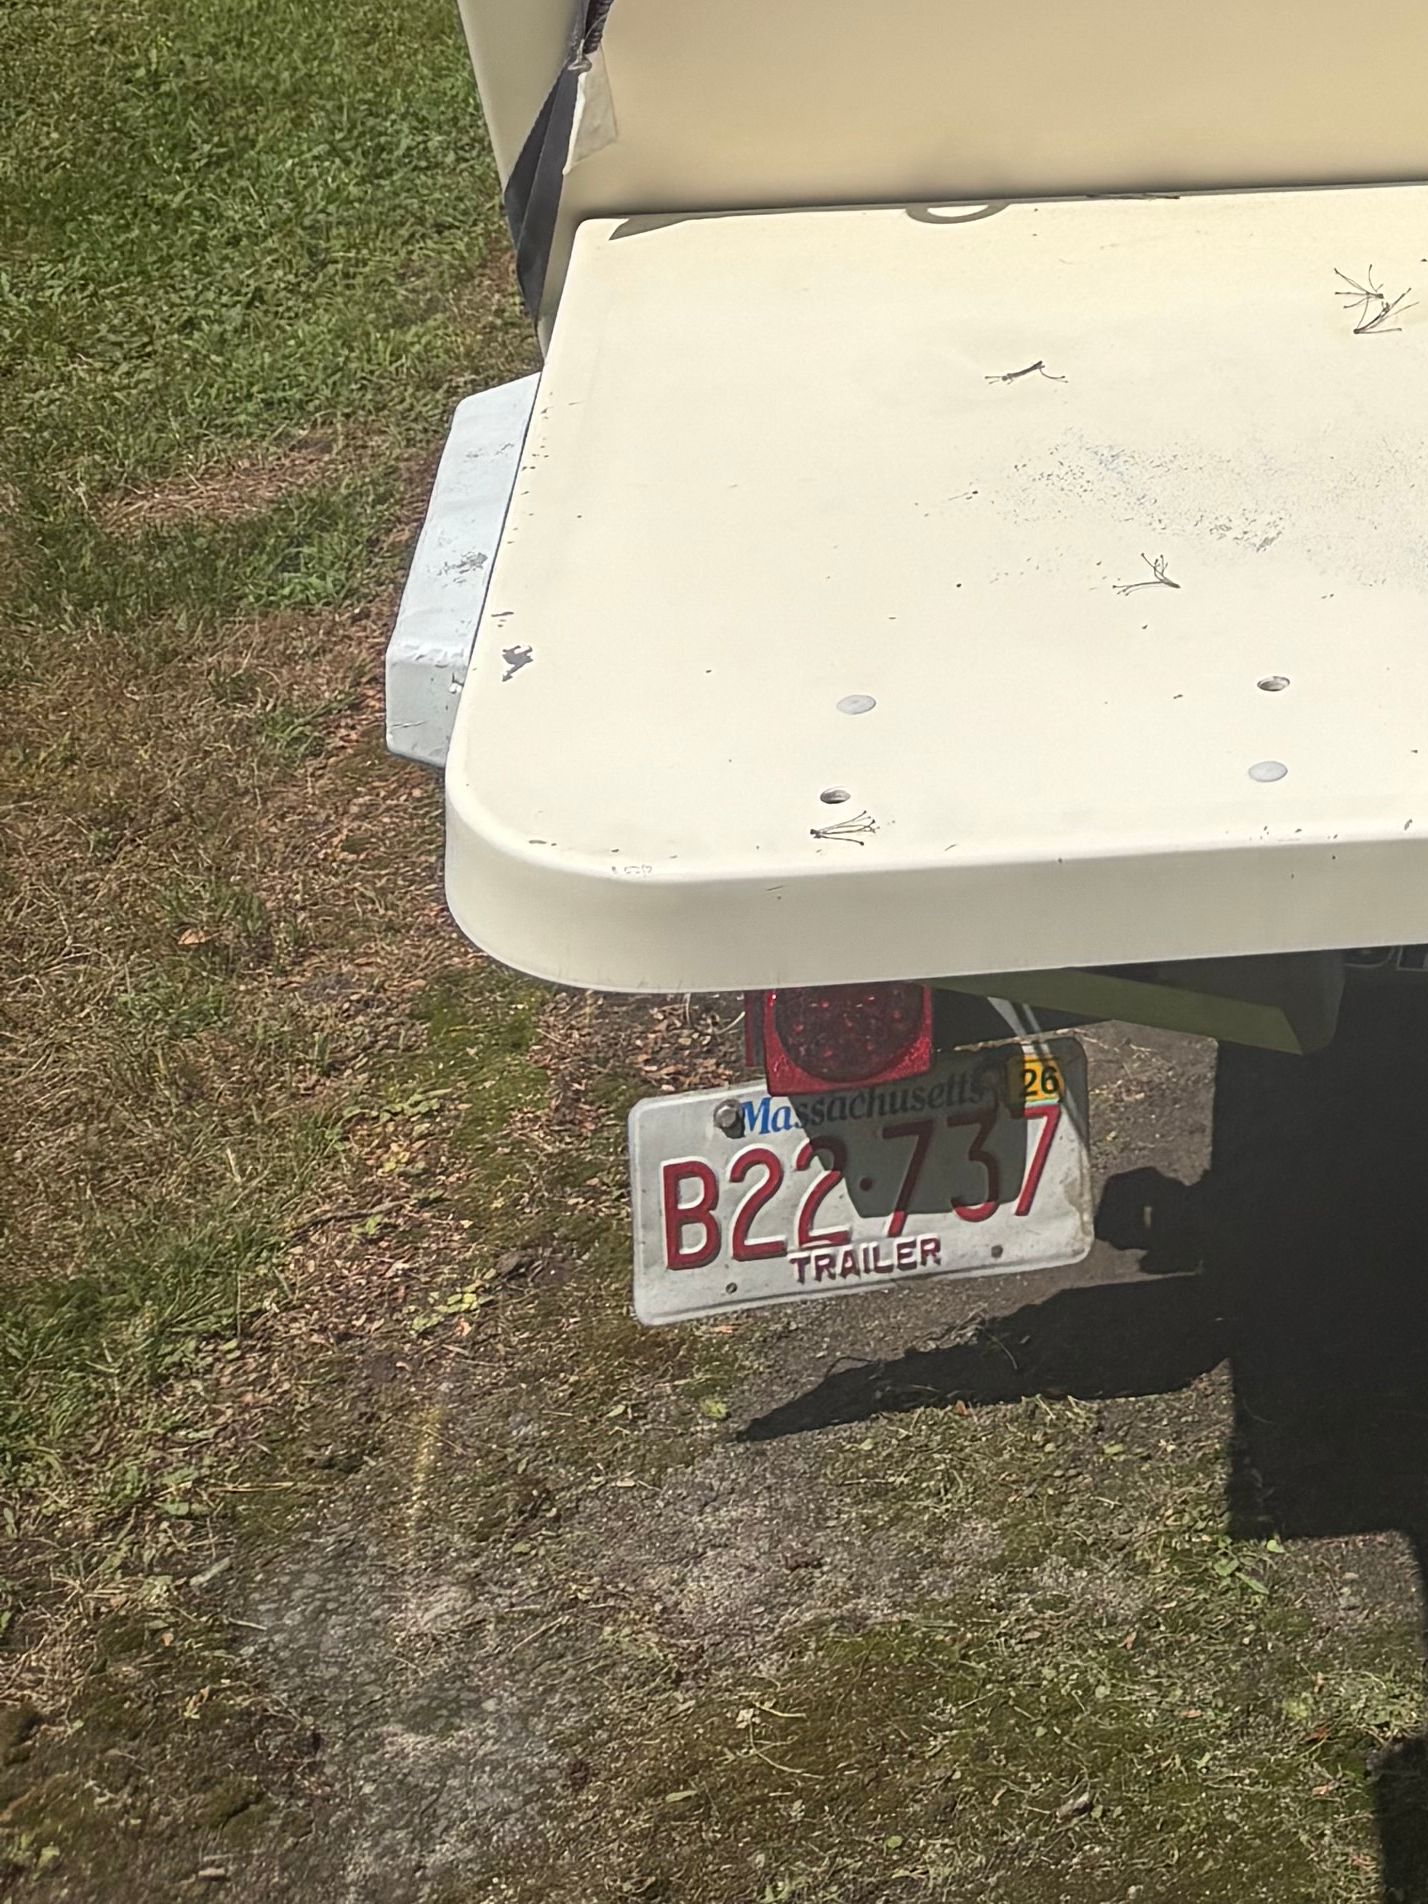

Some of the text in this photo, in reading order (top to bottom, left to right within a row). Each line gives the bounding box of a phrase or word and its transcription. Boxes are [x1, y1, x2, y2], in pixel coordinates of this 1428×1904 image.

[740, 1072, 985, 1138] Massachusetts
[1022, 1065, 1060, 1097] 26
[789, 1233, 941, 1284] TRAILER
